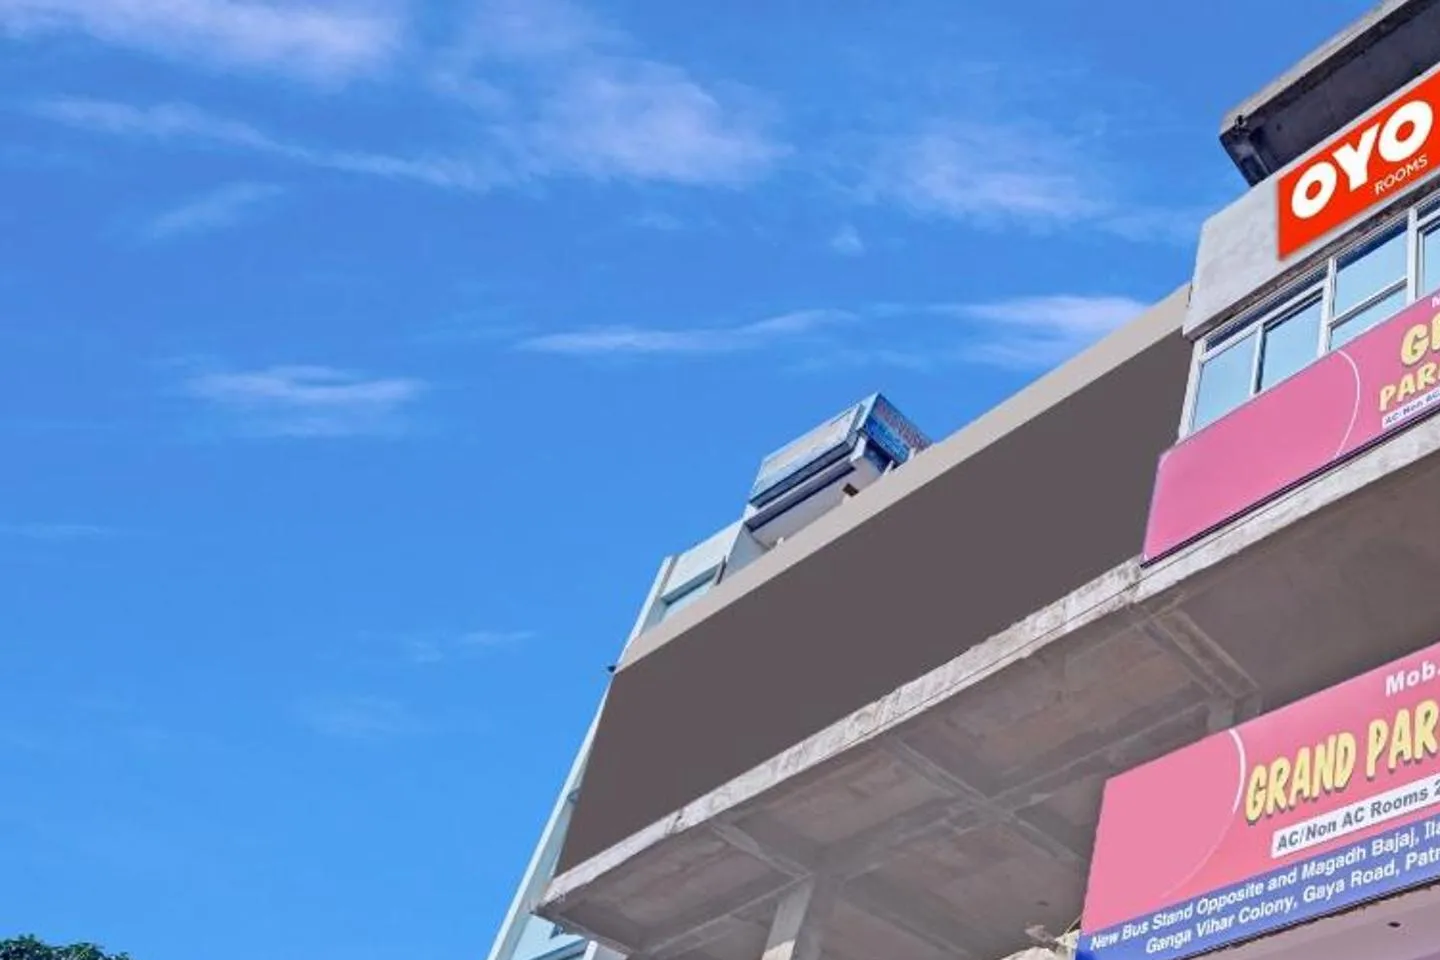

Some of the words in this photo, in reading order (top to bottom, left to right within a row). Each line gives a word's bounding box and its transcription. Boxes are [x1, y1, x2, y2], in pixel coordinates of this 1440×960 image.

[1291, 100, 1433, 219] OYO
[1374, 155, 1428, 195] ROOMS
[1245, 731, 1356, 824] GRAND
[1277, 820, 1338, 852] AC/Non
[1341, 808, 1365, 828] AC
[1370, 789, 1430, 820] Rooms
[1090, 934, 1118, 951] New
[1122, 922, 1149, 939] Bus
[1153, 903, 1193, 930] Stand
[1196, 882, 1264, 915] Opposite
[1267, 869, 1298, 892] and
[1301, 845, 1367, 880] Magadh
[1371, 831, 1420, 857] Bajaj,
[1146, 929, 1192, 954] Ganga
[1196, 913, 1233, 938] Vihar
[1238, 895, 1298, 926] Colony,
[1303, 877, 1345, 907] Gaya
[1350, 858, 1400, 890] Road,
